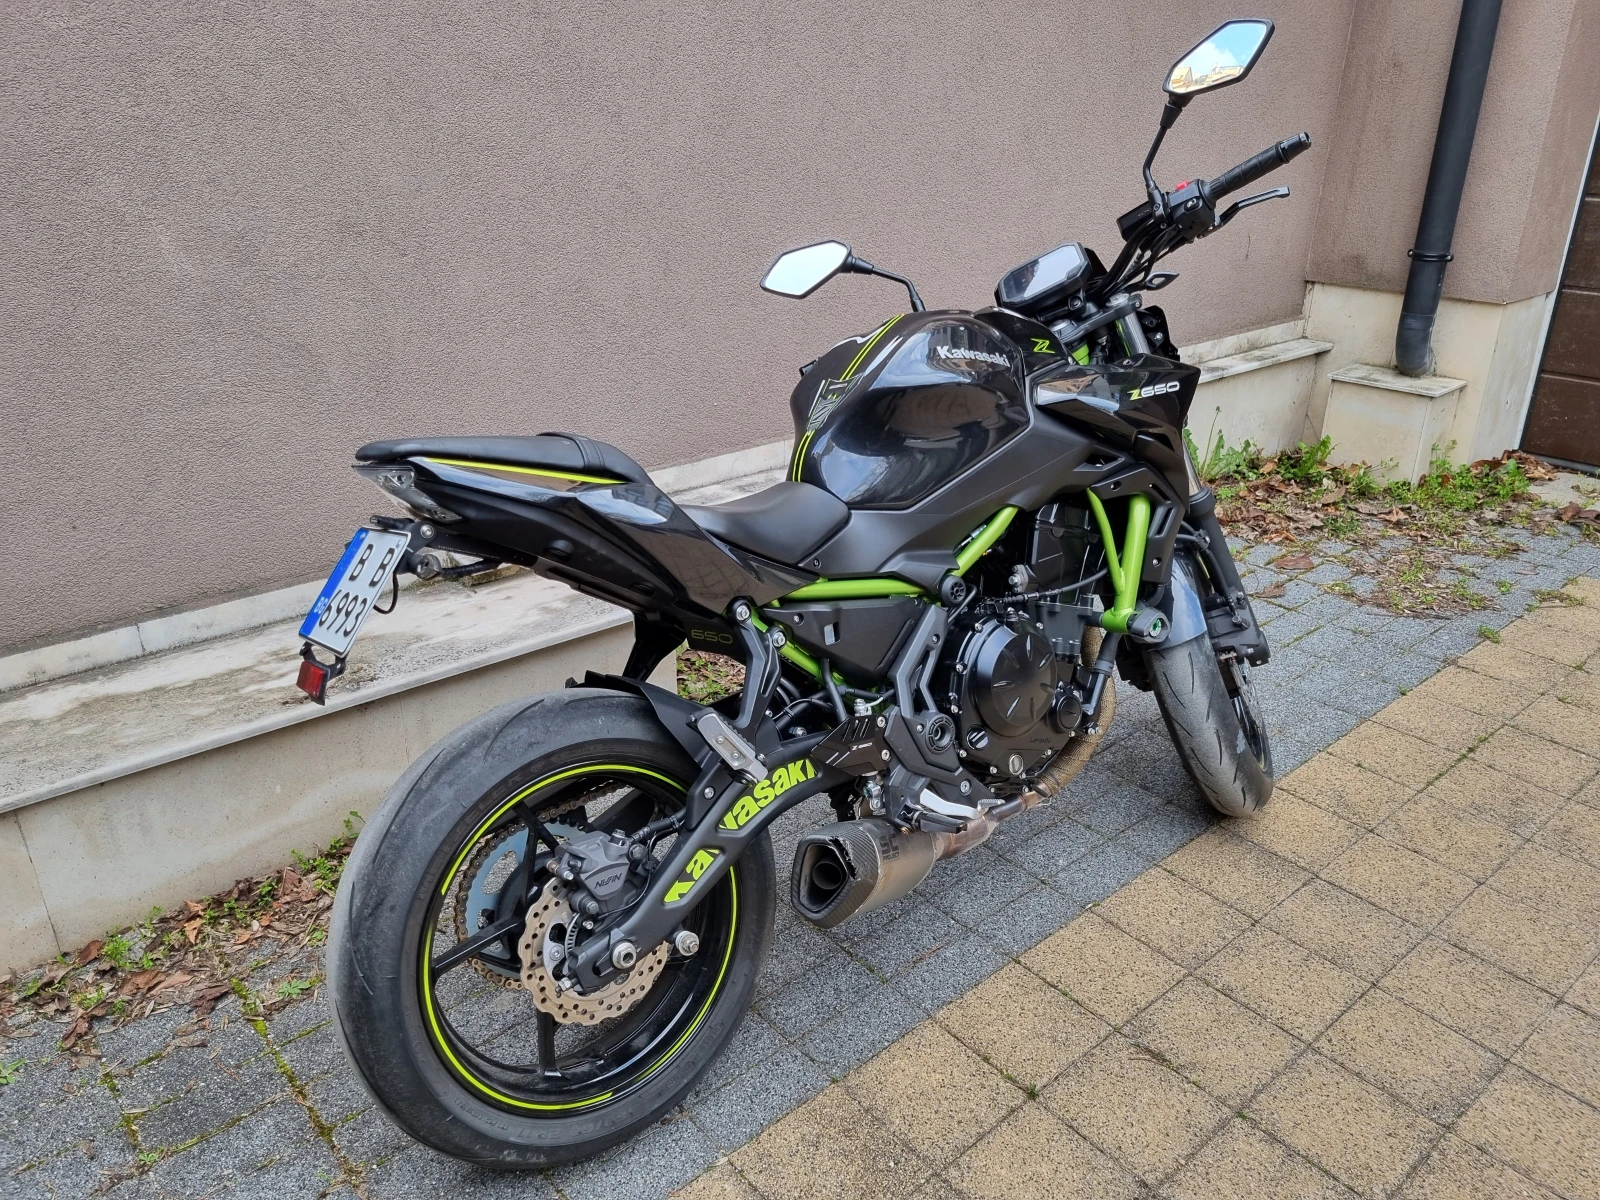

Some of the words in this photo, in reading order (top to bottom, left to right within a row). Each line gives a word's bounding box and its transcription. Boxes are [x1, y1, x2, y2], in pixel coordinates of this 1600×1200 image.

[937, 345, 1011, 368] Kawasaki
[1127, 381, 1181, 401] Z650
[349, 544, 374, 581] B
[368, 548, 395, 587] B
[314, 596, 329, 615] BG
[318, 589, 368, 638] 6993
[690, 629, 734, 644] 650
